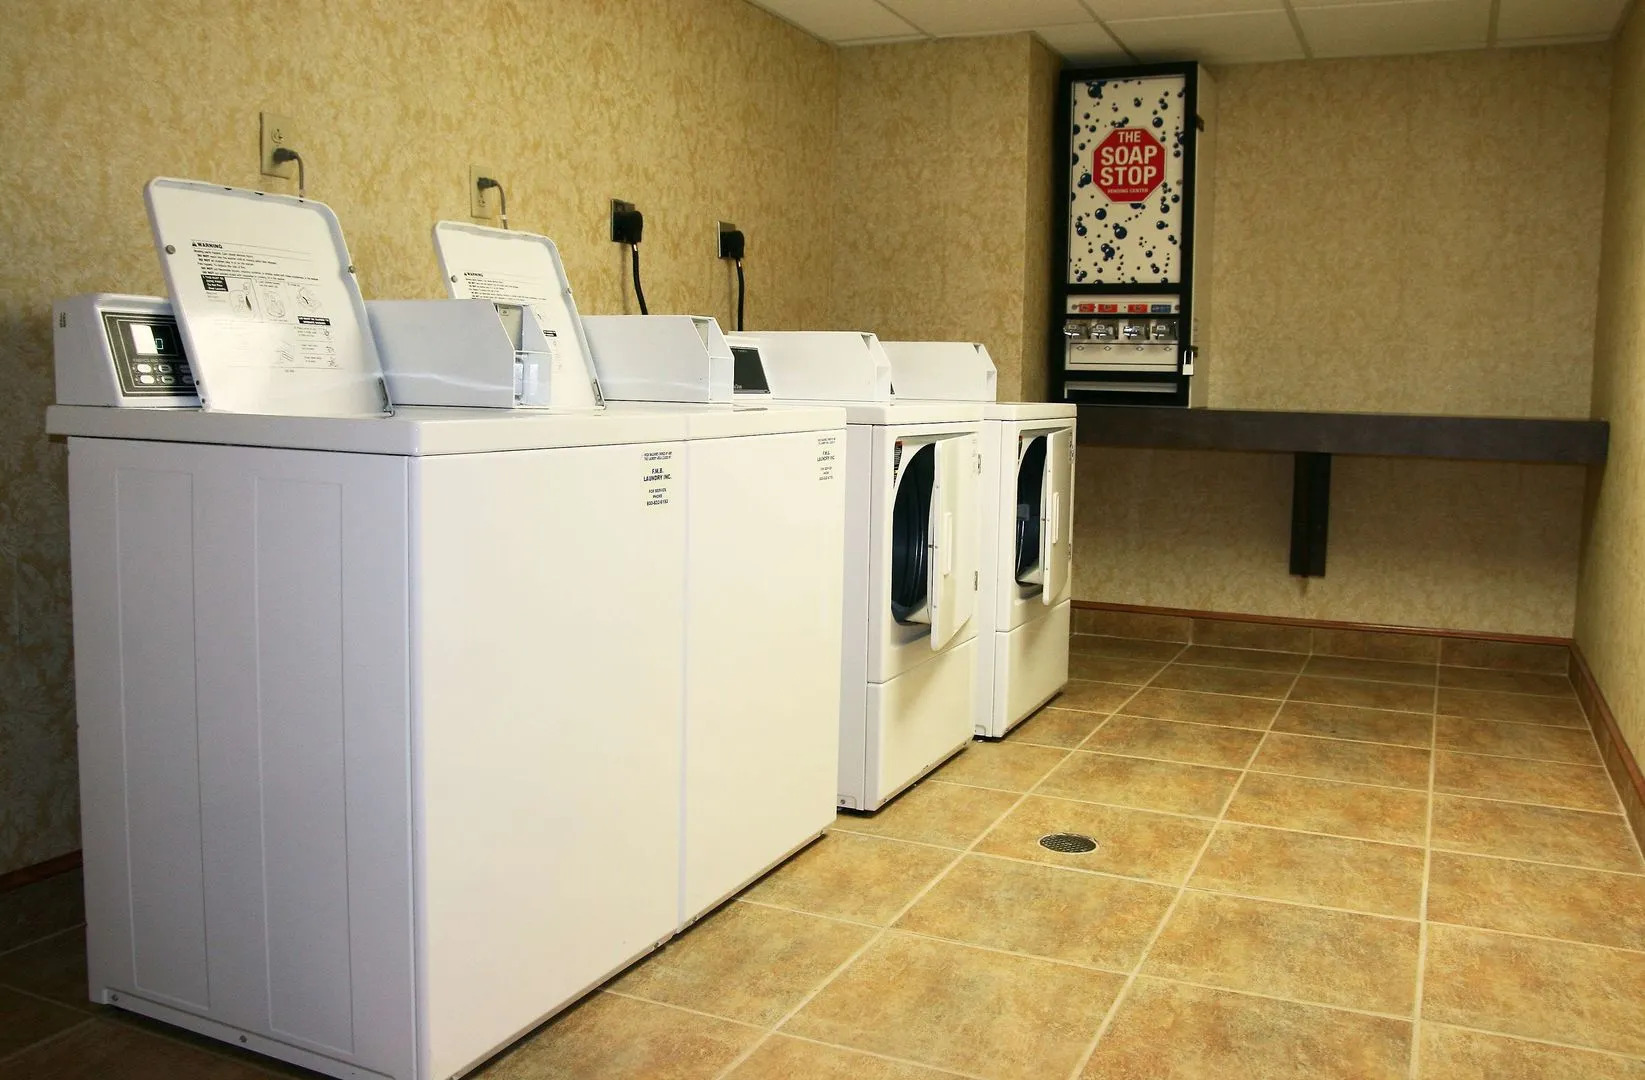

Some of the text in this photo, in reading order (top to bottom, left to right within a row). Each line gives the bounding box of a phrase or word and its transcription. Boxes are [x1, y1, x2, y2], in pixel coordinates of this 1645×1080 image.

[1118, 131, 1141, 143] THE
[1101, 145, 1158, 166] SOAP
[1100, 165, 1157, 186] STOP
